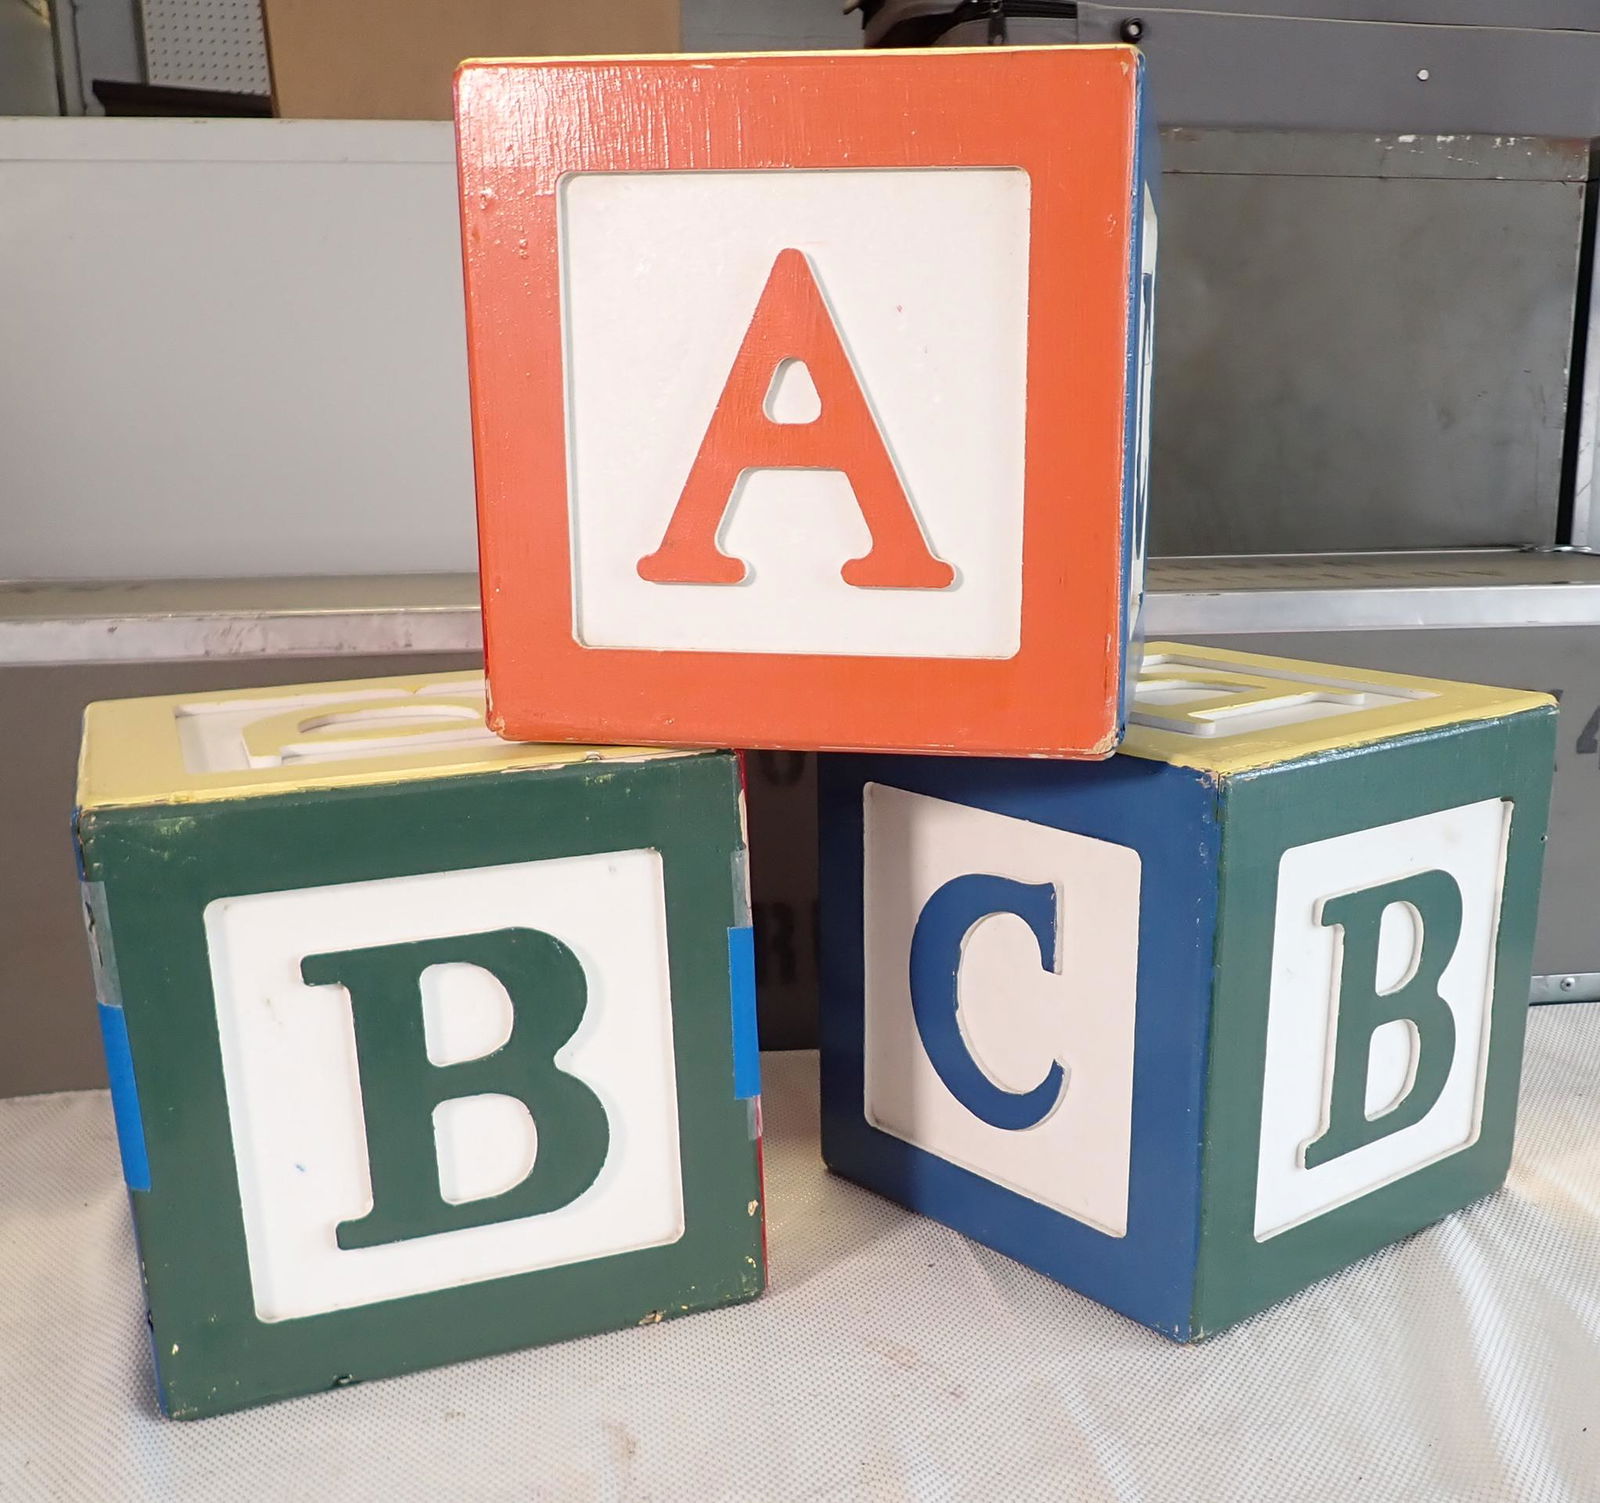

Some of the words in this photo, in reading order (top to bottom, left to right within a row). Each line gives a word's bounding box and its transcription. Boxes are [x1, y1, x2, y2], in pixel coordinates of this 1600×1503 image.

[636, 248, 956, 590] A
[300, 926, 610, 1251] B
[909, 872, 1066, 1131] C
[1303, 869, 1463, 1170] B
